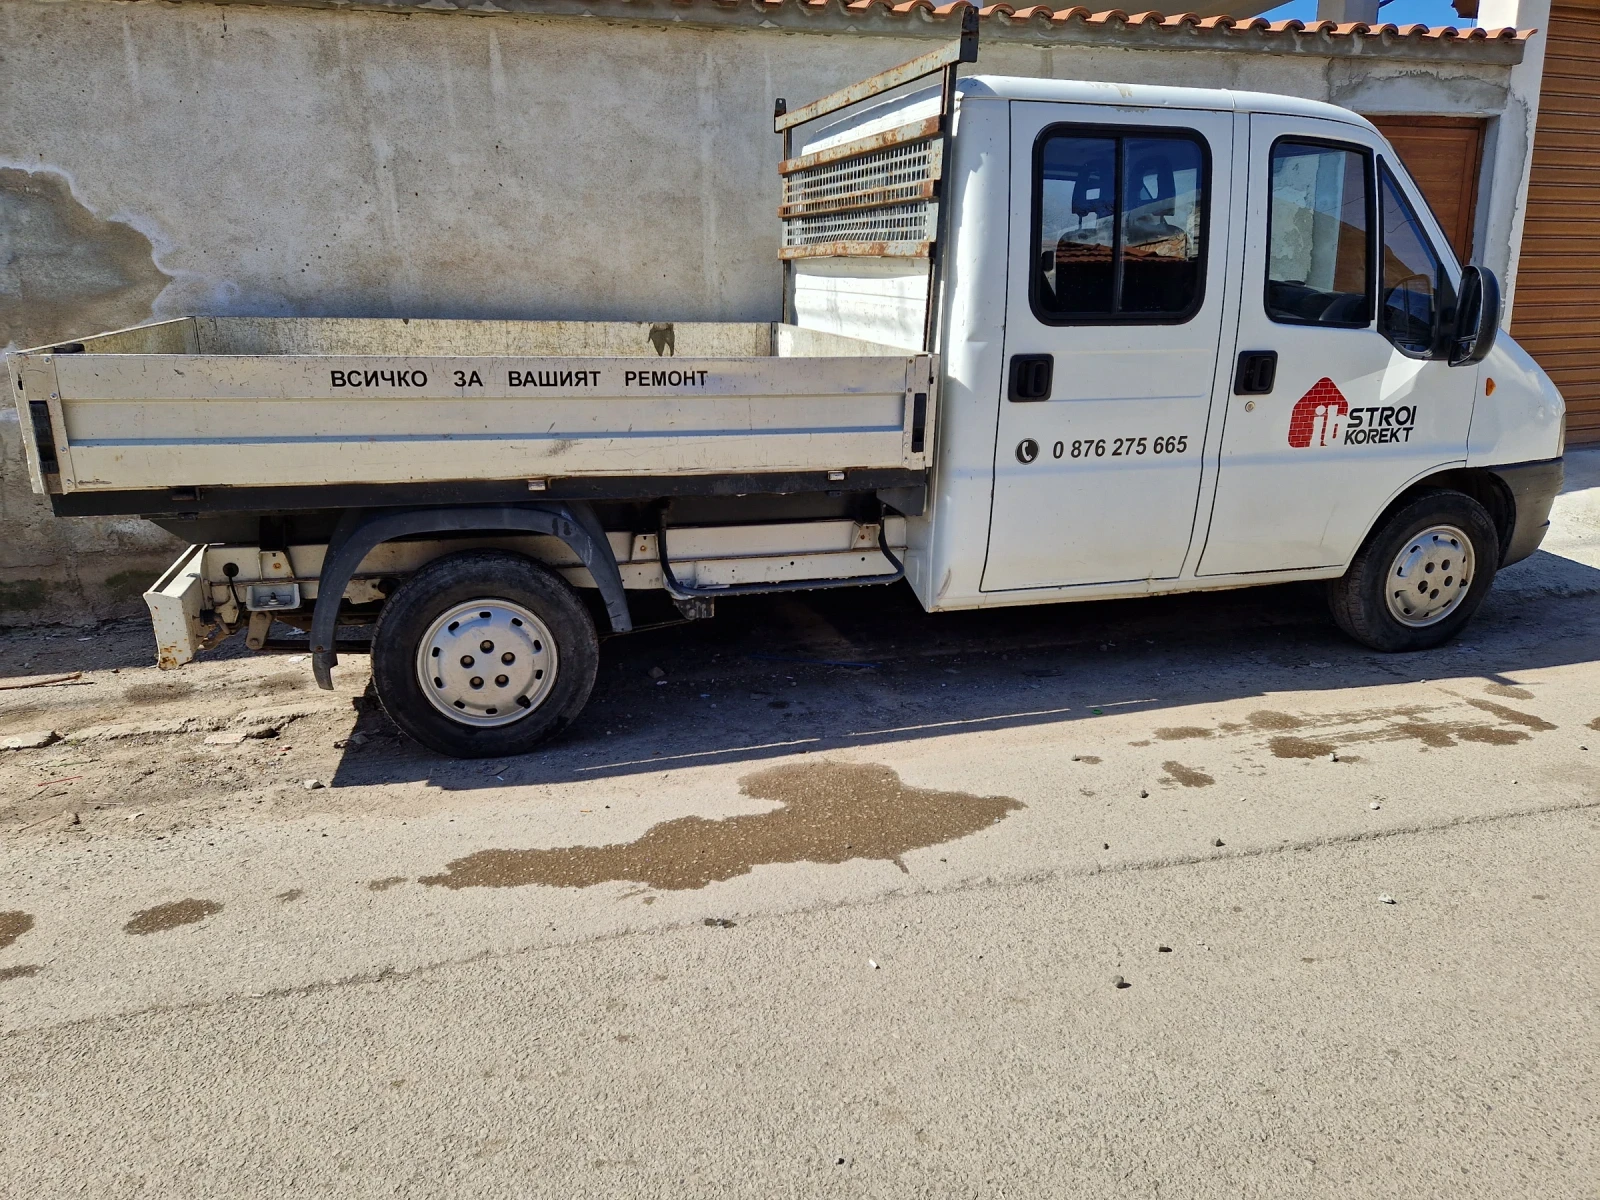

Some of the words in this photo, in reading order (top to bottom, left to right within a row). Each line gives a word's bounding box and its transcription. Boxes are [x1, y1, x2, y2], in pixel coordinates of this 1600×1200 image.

[329, 370, 428, 388] ВСИЧКО
[453, 370, 483, 387] ЗА
[508, 370, 602, 387] ВАШИЯТ
[625, 370, 708, 387] РЕМОНТ
[1347, 405, 1417, 428] STROI
[1343, 426, 1414, 445] KOREKT
[1052, 440, 1065, 459] 0
[1070, 439, 1106, 458] 876
[1111, 437, 1148, 456] 275
[1153, 435, 1188, 454] 665
